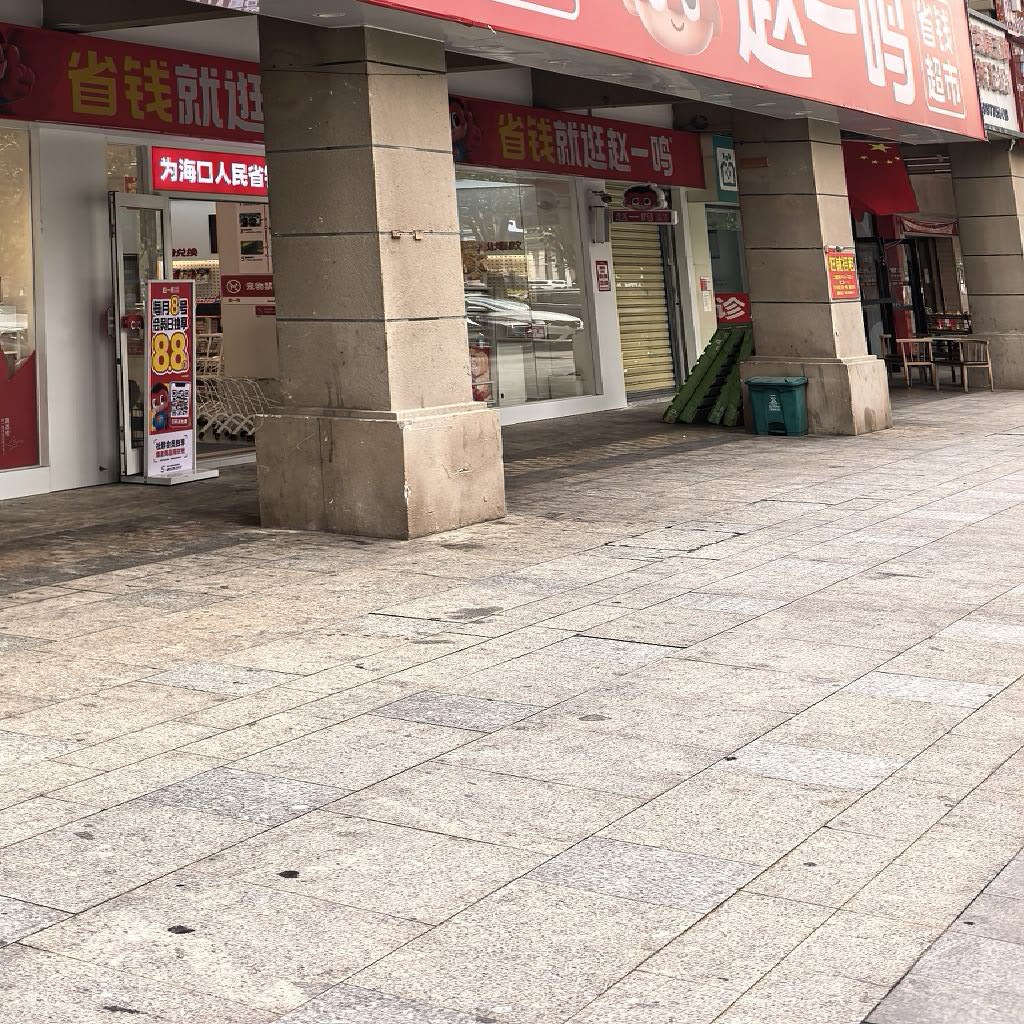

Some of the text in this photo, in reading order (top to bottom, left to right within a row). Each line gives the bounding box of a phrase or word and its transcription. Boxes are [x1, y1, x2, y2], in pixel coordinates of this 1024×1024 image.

[917, 0, 953, 54] 省钱
[926, 54, 961, 106] 超市
[499, 112, 673, 176] 省钱就逛赵一鸣
[160, 156, 268, 188] 为海口人民省
